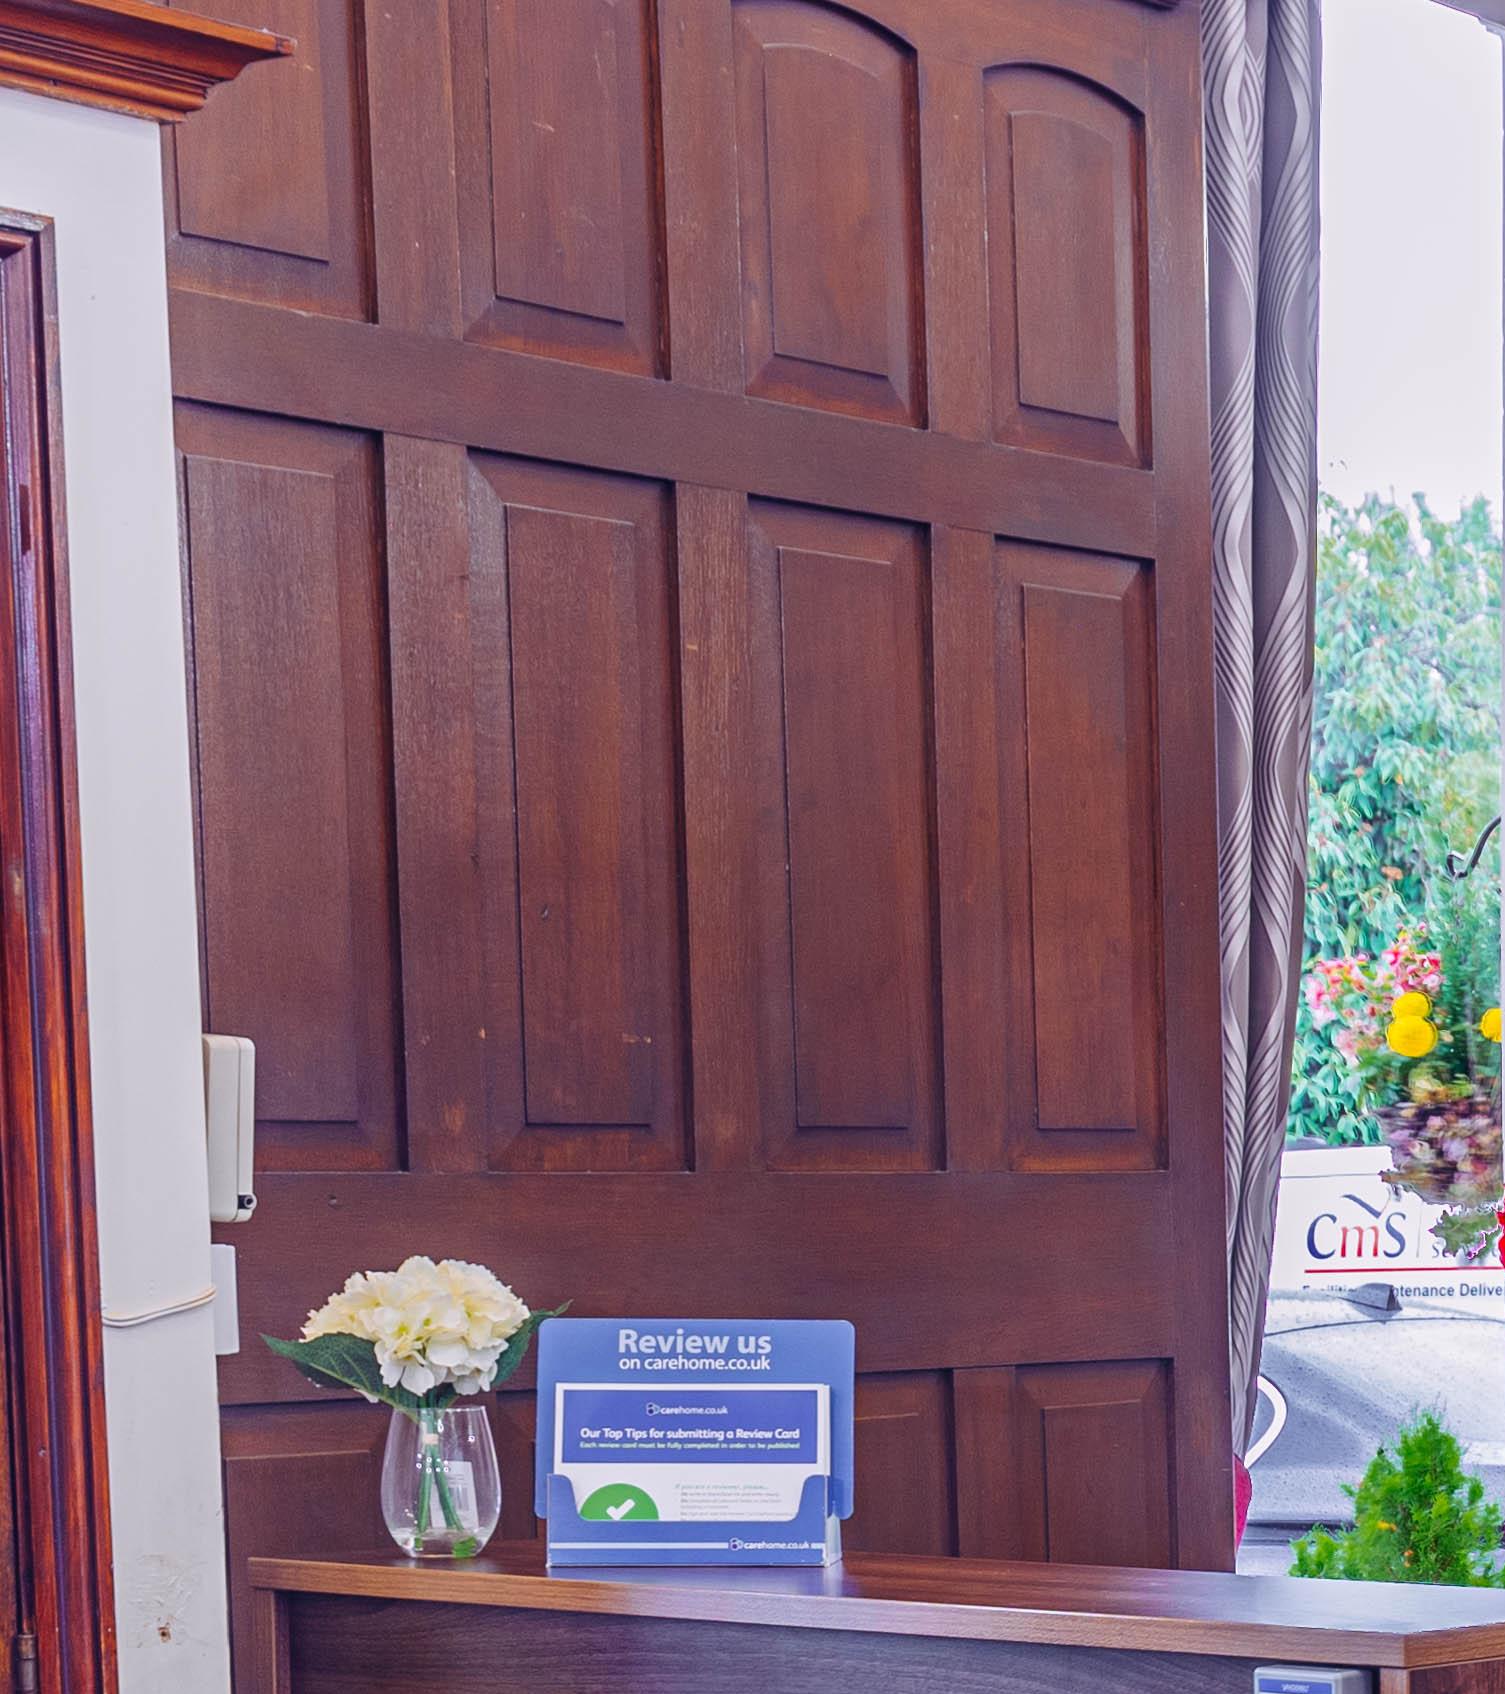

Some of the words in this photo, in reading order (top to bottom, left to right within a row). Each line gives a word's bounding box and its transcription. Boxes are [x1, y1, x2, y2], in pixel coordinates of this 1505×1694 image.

[618, 1328, 730, 1354] Review
[737, 1335, 772, 1354] us
[619, 1358, 640, 1370] on
[644, 1355, 771, 1371] carehome.co.uk
[660, 1405, 728, 1415] carehome.co.uk
[580, 1428, 601, 1439] Our
[602, 1428, 623, 1441] Top
[624, 1428, 648, 1441] Tips
[649, 1428, 665, 1439] for
[666, 1428, 724, 1441] submitting
[726, 1430, 734, 1439] a
[736, 1428, 773, 1439] Review
[774, 1428, 800, 1439] Card
